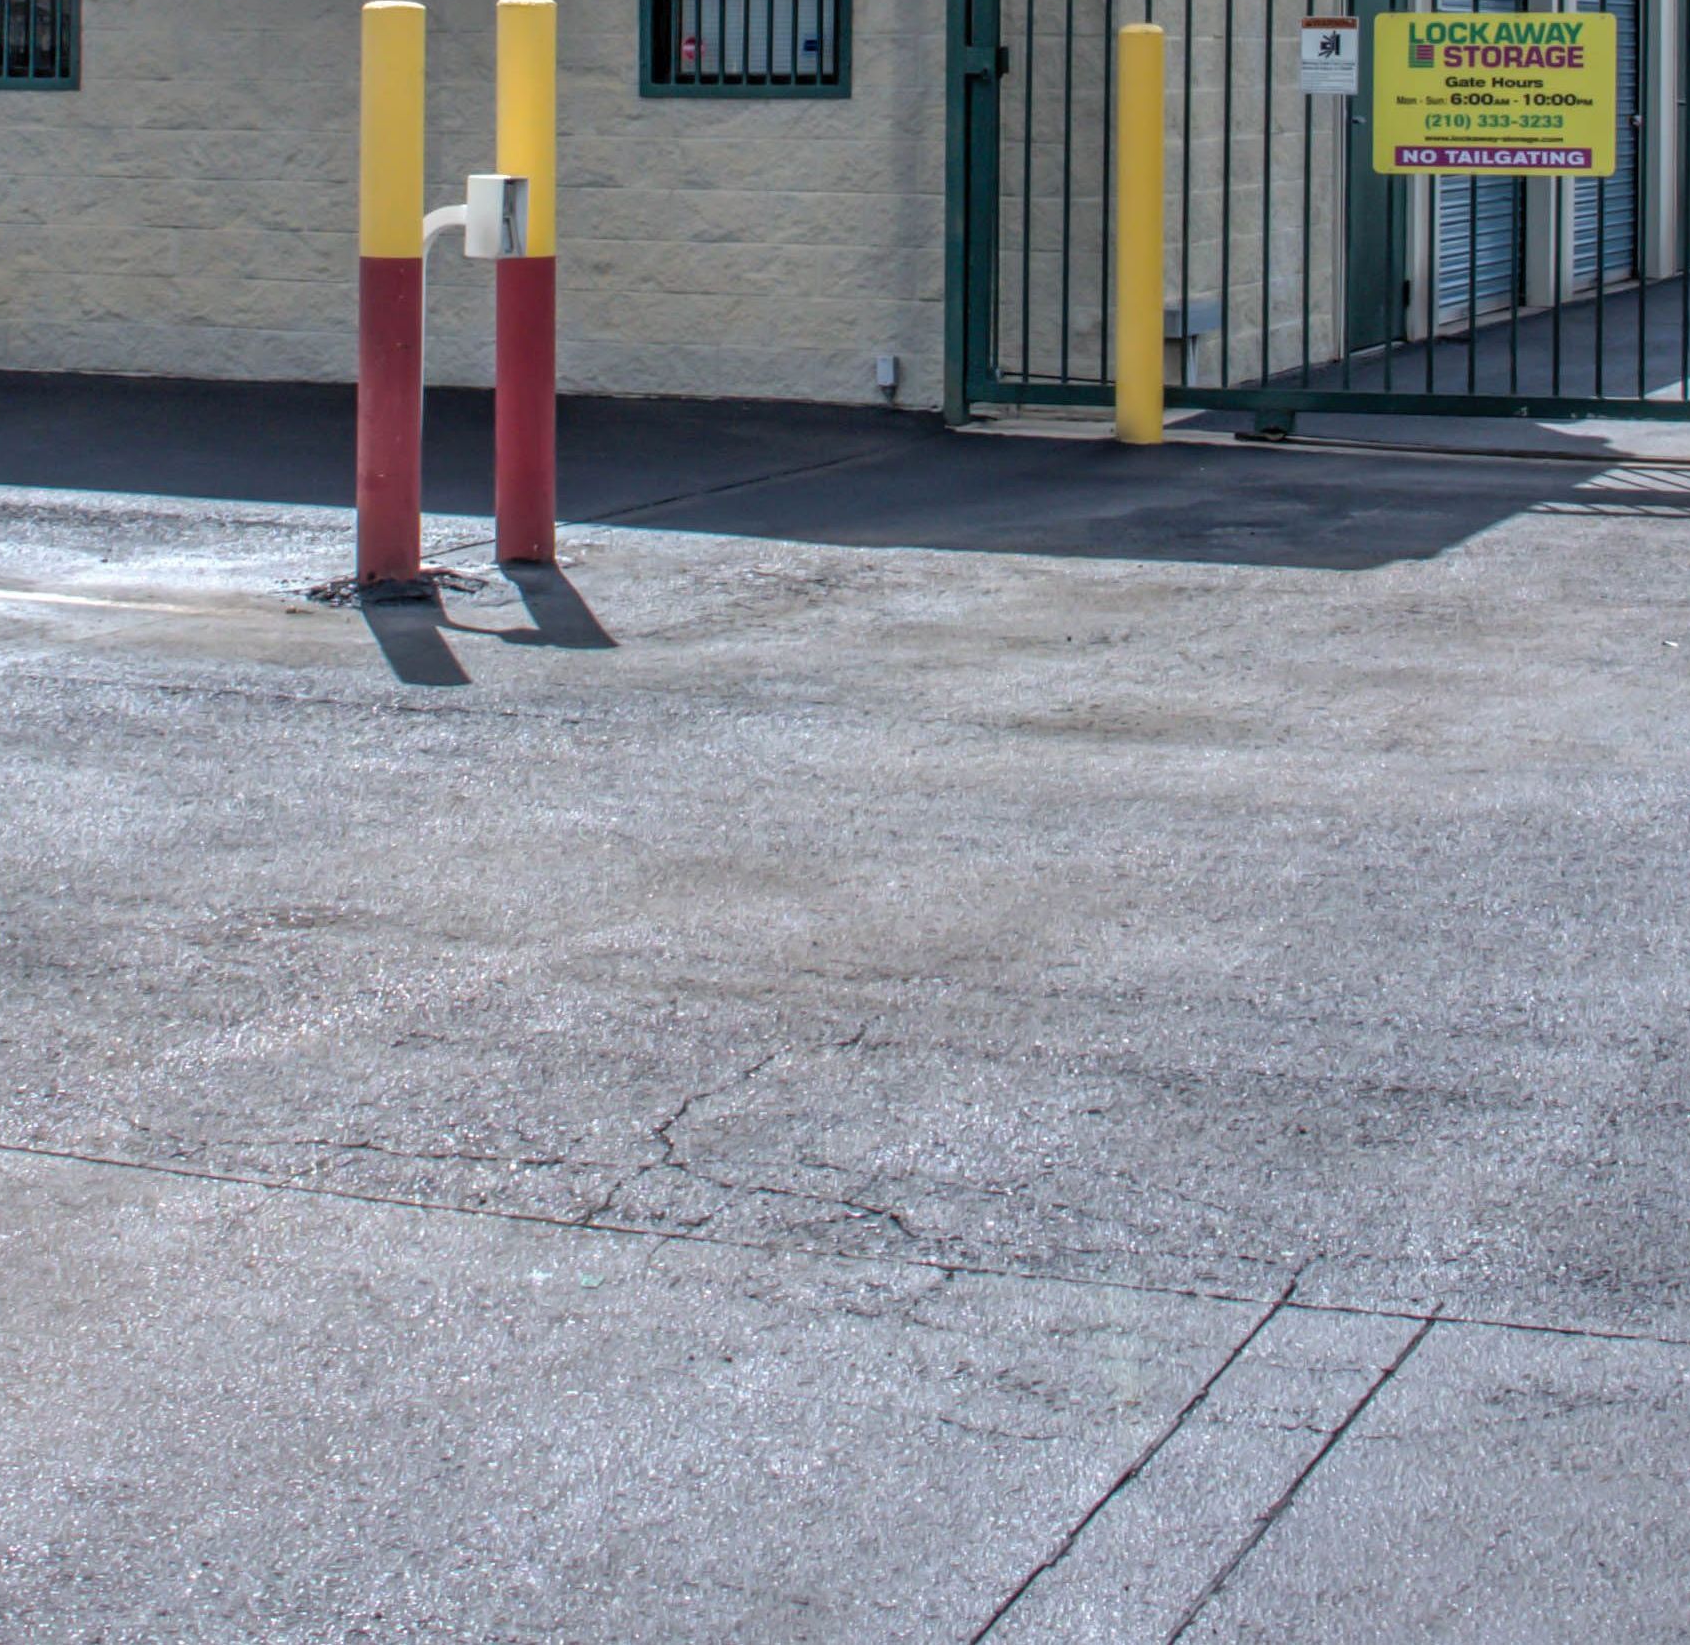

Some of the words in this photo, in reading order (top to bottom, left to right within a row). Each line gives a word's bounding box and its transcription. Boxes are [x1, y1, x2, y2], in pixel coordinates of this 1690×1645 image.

[1443, 45, 1584, 68] STORAGE
[1445, 76, 1486, 88] Gate
[1492, 77, 1544, 88] Hours
[1396, 96, 1417, 105] Mon
[1425, 113, 1471, 130] (210)
[1477, 114, 1564, 129] 333-3233
[1402, 149, 1437, 164] NO
[1445, 150, 1585, 166] TAILGATING
